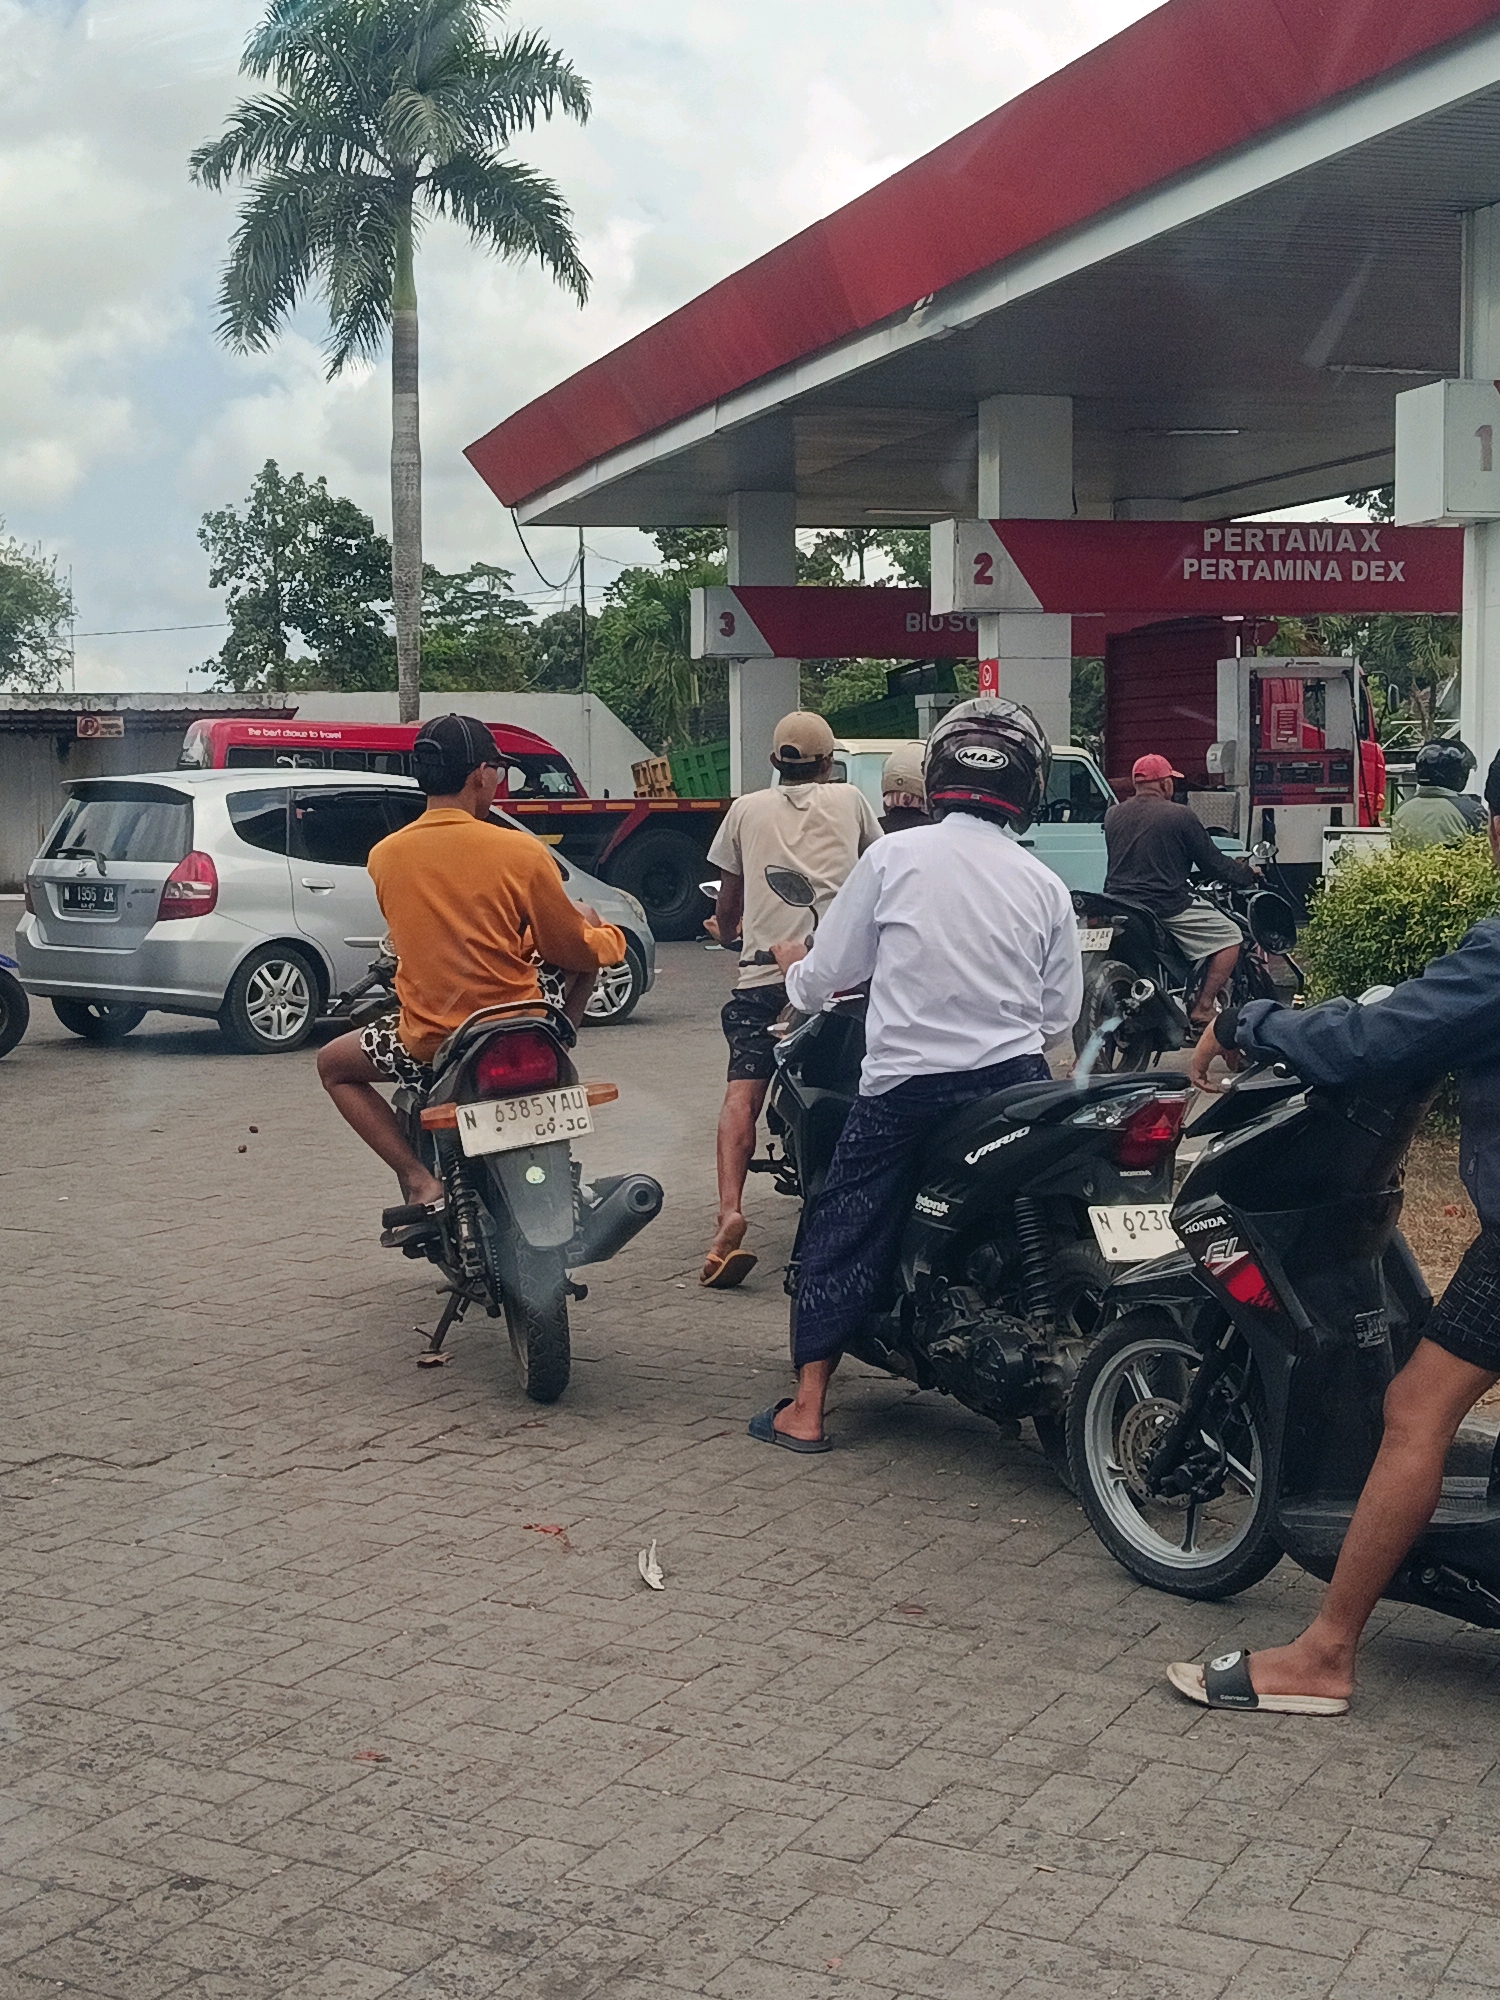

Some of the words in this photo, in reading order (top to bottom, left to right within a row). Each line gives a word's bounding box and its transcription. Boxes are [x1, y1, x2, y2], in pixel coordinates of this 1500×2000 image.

[1475, 425, 1493, 472] 1
[1203, 528, 1381, 553] PERTAMAX
[973, 552, 994, 585] 2
[1183, 558, 1343, 582] PERTAMINA
[1351, 560, 1406, 582] DEX
[719, 611, 735, 637] 3
[905, 612, 944, 633] BIO
[309, 730, 318, 738] to
[320, 730, 341, 739] travel
[960, 752, 1002, 764] MAZ
[464, 1110, 478, 1131] N
[495, 1097, 544, 1123] 6385
[1097, 1212, 1114, 1233] N
[1184, 1215, 1228, 1235] HONDA
